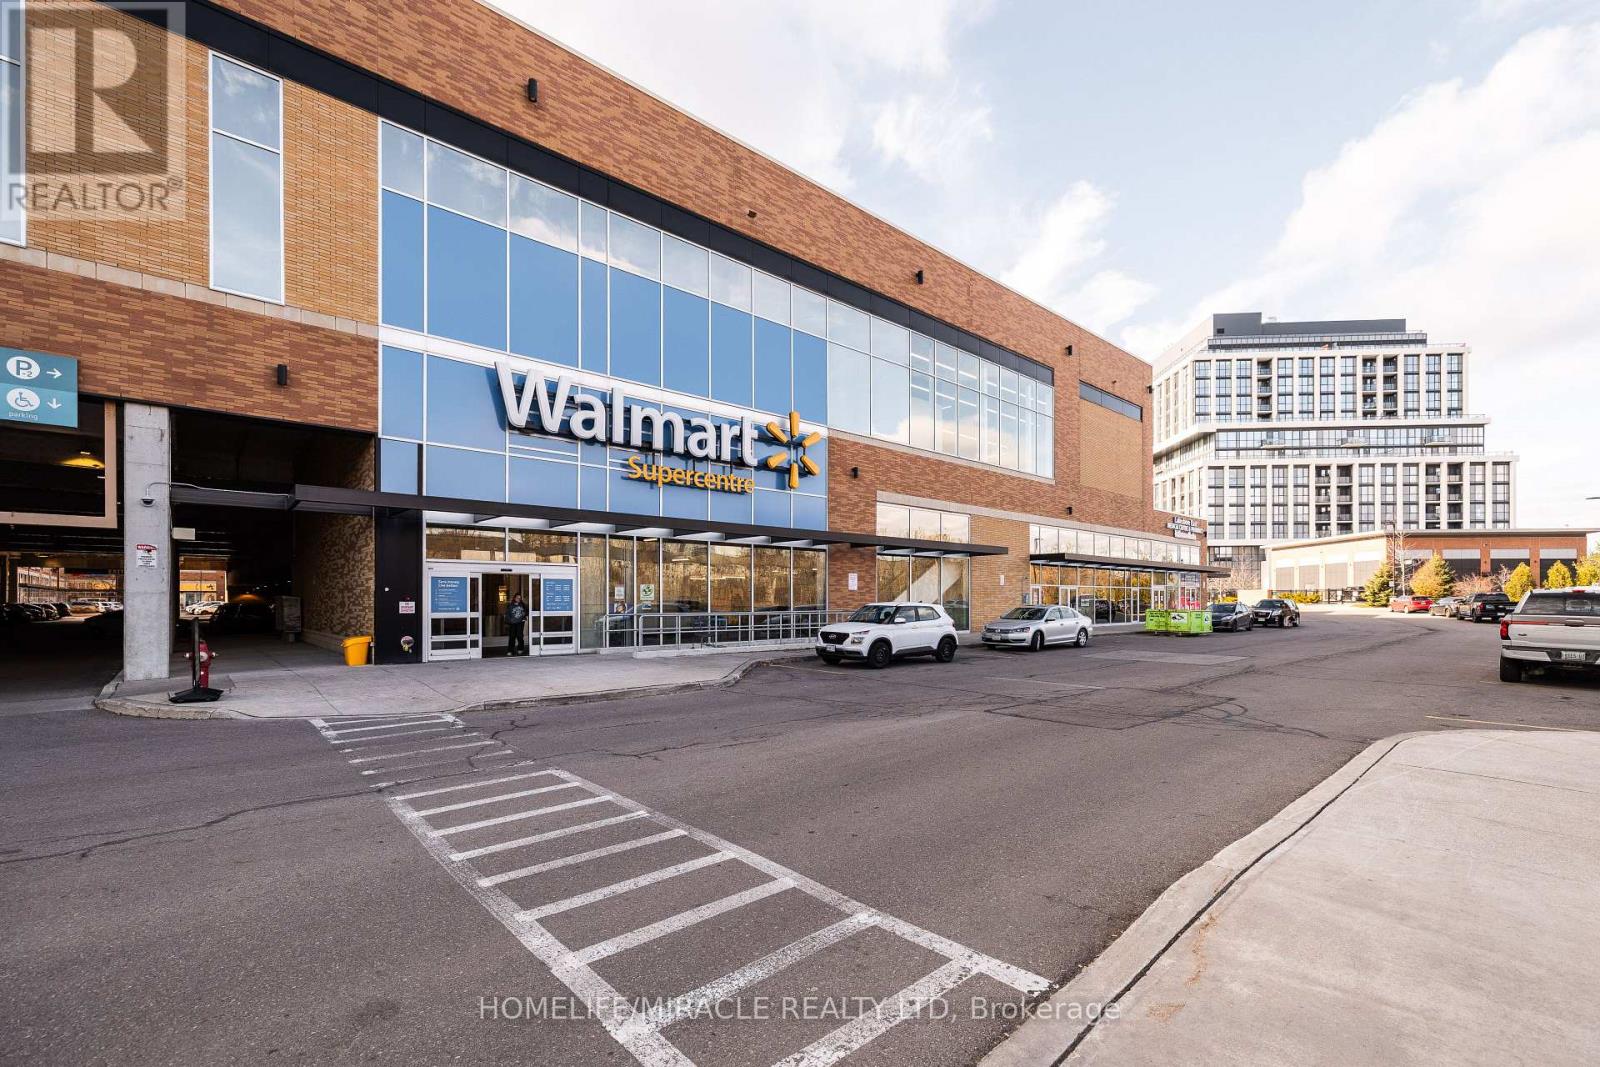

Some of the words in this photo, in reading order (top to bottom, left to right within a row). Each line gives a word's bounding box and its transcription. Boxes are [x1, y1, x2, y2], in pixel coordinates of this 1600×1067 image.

[8, 411, 39, 420] parking
[494, 361, 759, 467] Walmart
[627, 455, 755, 494] Supercentre
